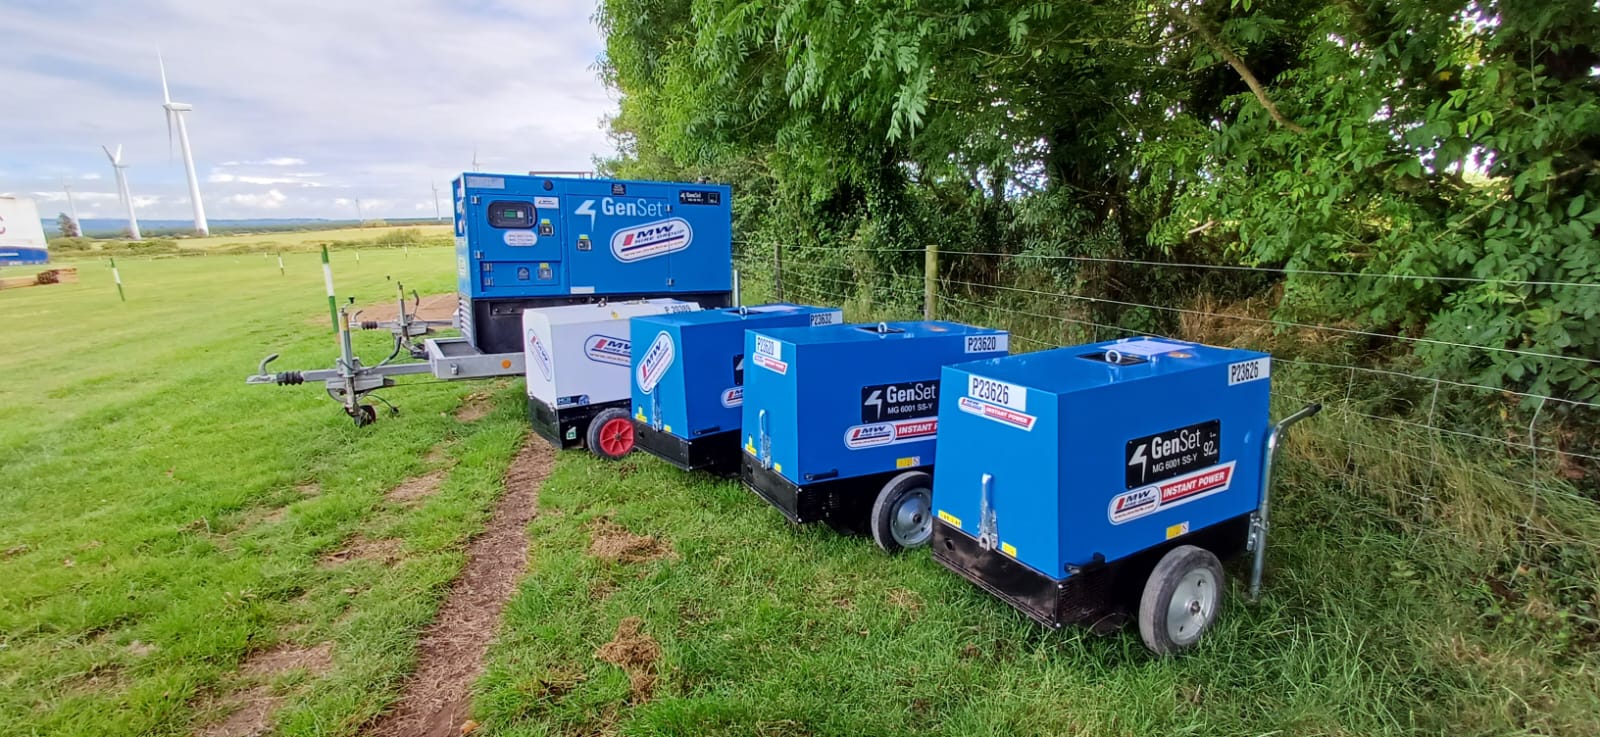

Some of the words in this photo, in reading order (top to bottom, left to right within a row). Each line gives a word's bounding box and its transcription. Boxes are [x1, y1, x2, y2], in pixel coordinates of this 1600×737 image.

[601, 197, 663, 217] GenSet
[810, 313, 833, 326] P23632
[967, 336, 996, 351] P23620
[1231, 361, 1259, 382] P23626
[886, 381, 937, 404] GenSet
[972, 377, 1009, 405] P23626
[887, 406, 900, 415] MG
[900, 404, 916, 414] 6001
[917, 403, 934, 412] SS-Y
[899, 423, 933, 434] INSTANT
[1151, 429, 1201, 460] GenSet
[1203, 440, 1213, 457] 92
[1152, 463, 1165, 473] MG
[1165, 458, 1181, 470] 6001
[1182, 453, 1198, 465] SS-Y
[1163, 481, 1198, 498] INSTANT
[1198, 471, 1225, 487] POWER
